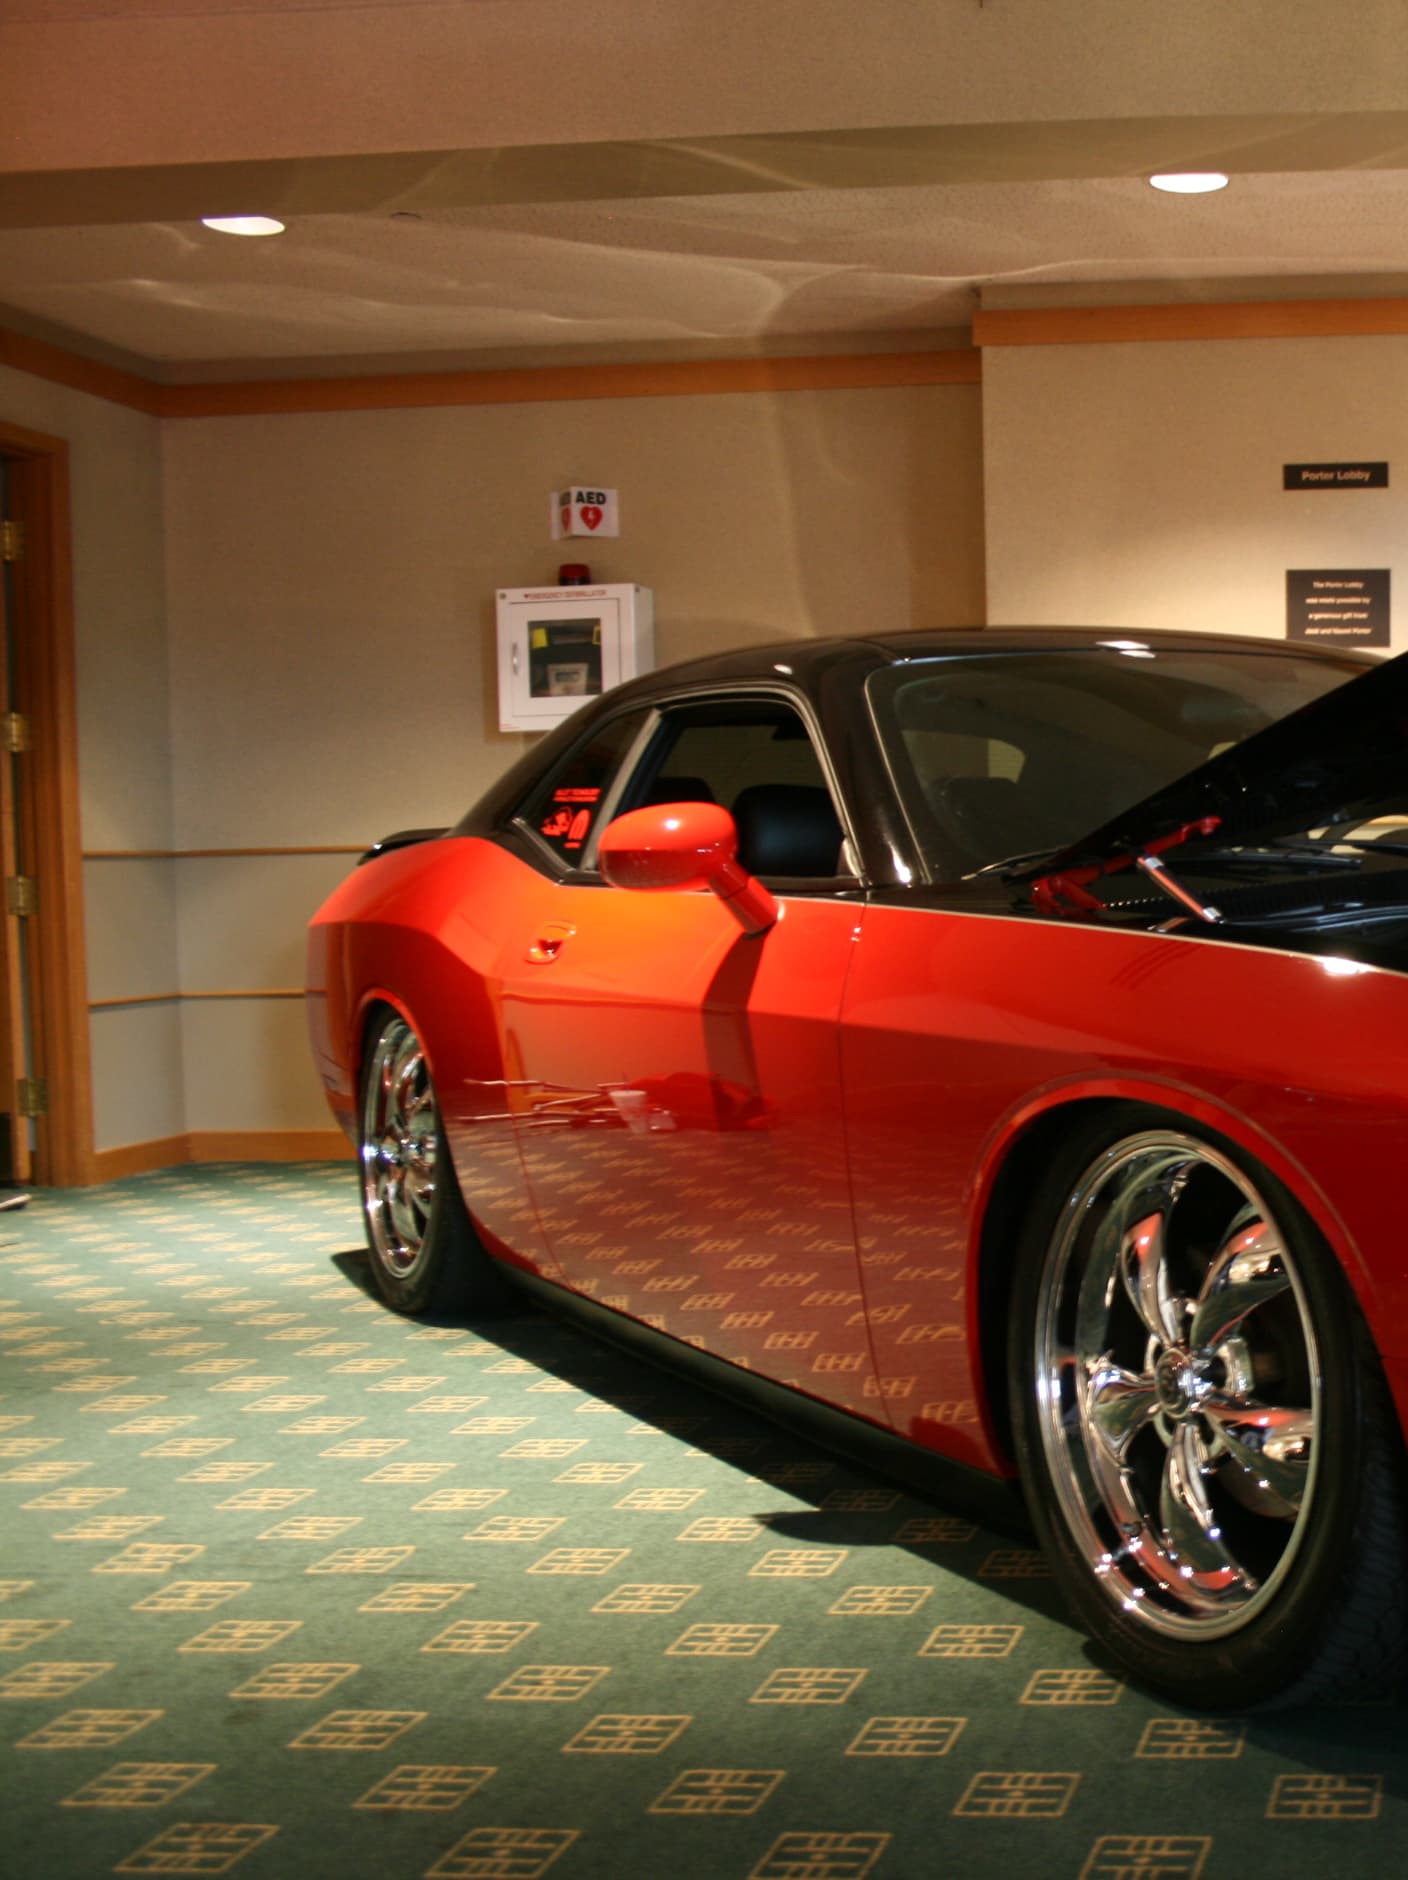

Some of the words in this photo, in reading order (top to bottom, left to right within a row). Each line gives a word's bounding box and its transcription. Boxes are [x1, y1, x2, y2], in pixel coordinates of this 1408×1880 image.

[1302, 470, 1335, 481] Porter
[1337, 470, 1370, 482] Lobby
[575, 491, 607, 505] AED
